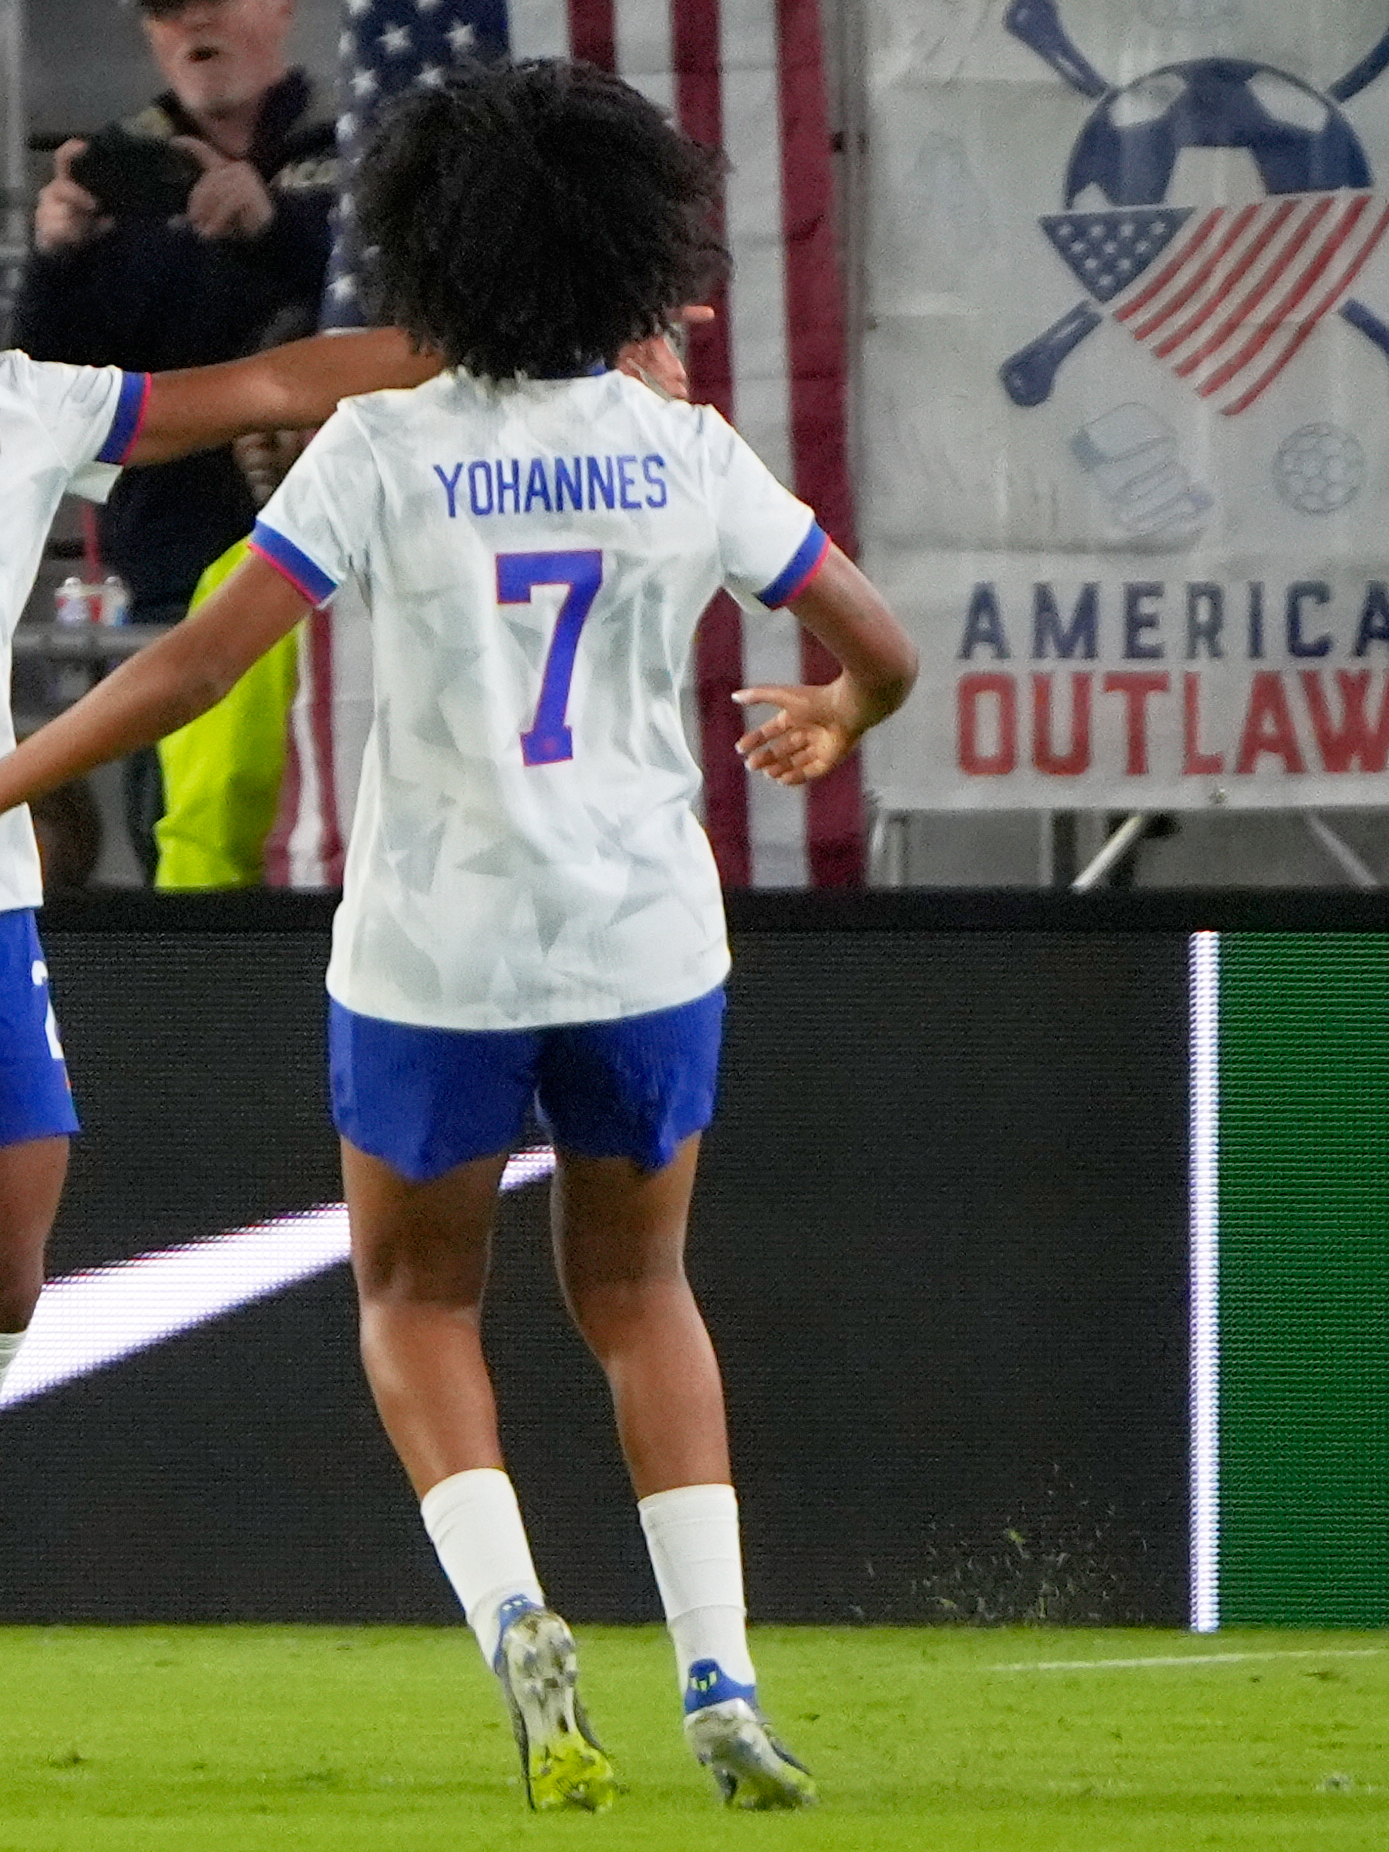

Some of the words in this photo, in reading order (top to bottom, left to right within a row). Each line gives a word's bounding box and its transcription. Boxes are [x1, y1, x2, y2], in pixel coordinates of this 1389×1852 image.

[432, 453, 668, 518] YOHANNES
[495, 549, 604, 767] 7
[957, 580, 1389, 660] AMERICA
[957, 669, 1389, 776] OUTLAW
